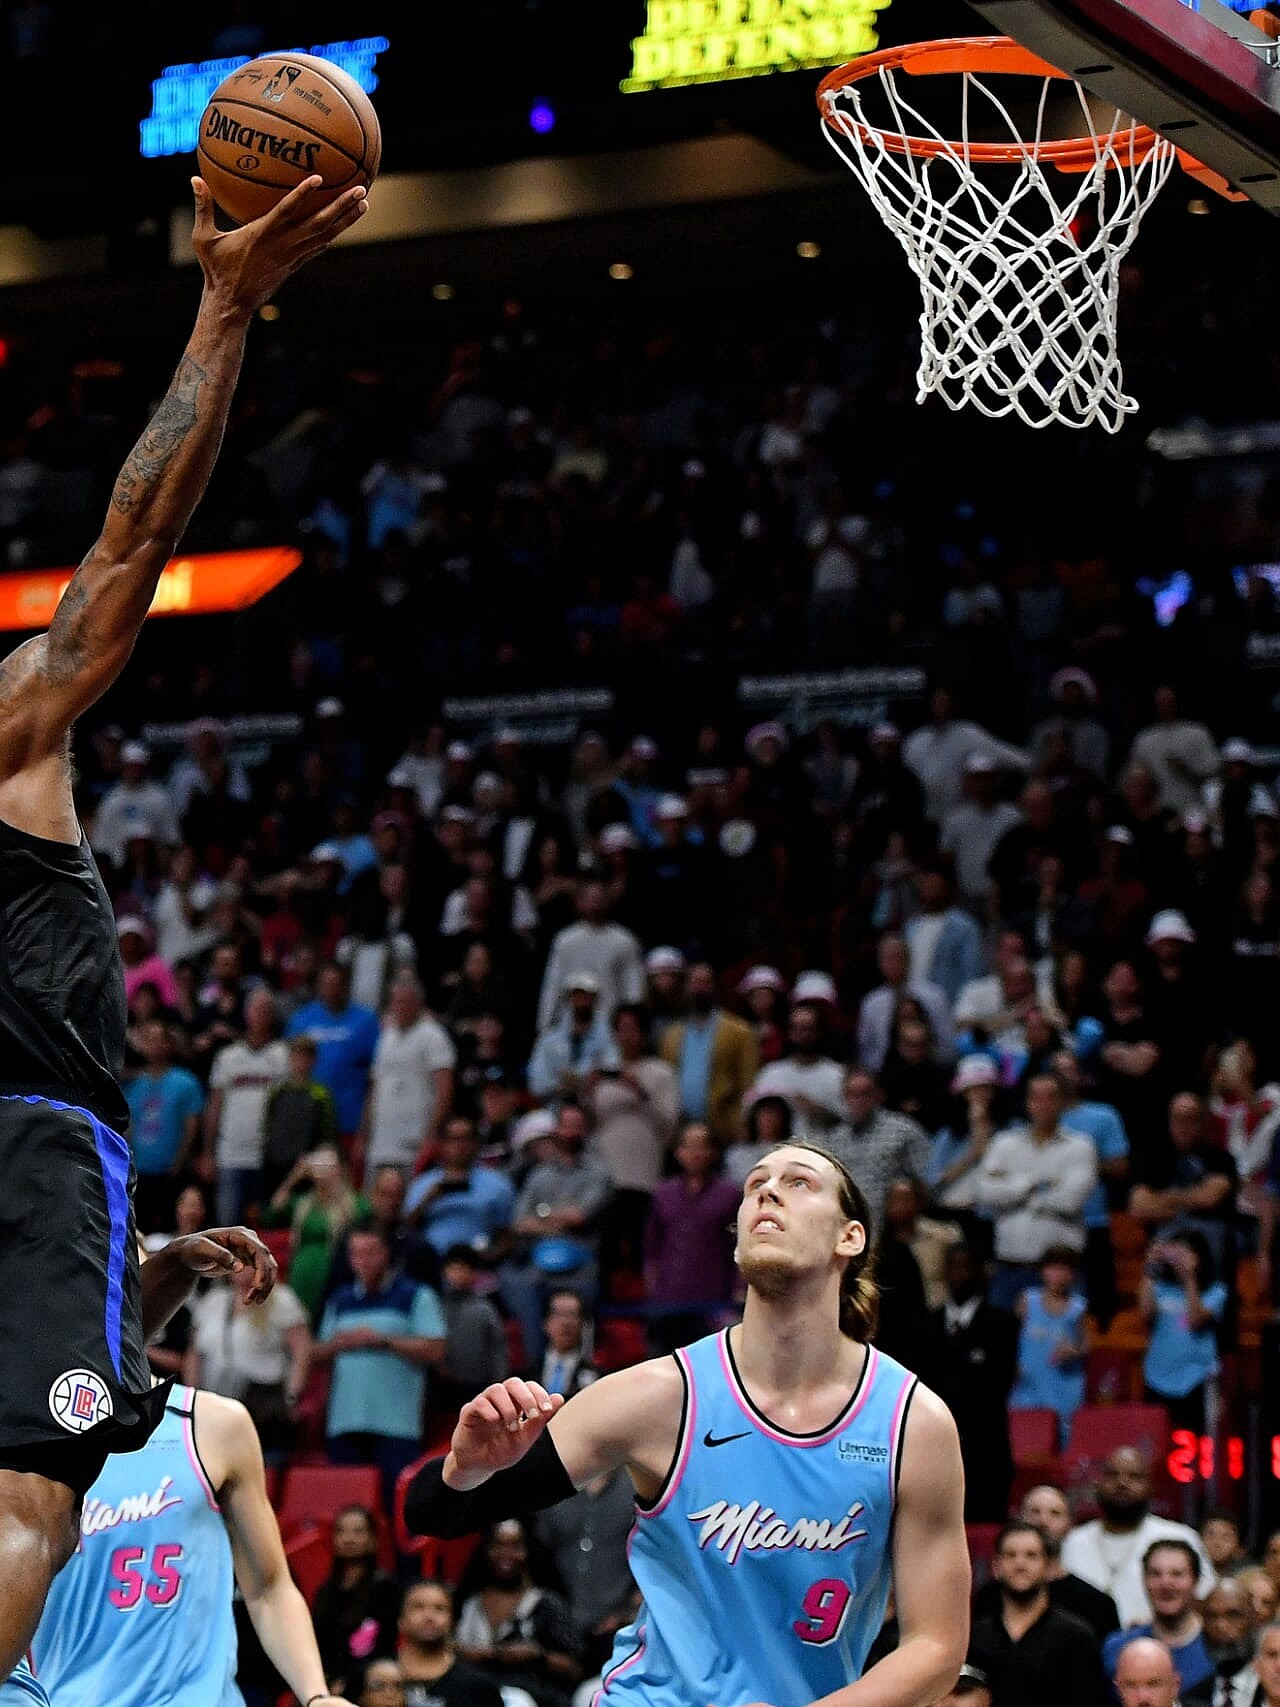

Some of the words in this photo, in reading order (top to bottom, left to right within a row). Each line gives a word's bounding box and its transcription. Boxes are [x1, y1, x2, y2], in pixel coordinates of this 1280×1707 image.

[205, 106, 320, 172] SPALDING
[839, 1440, 888, 1456] Ultimate
[80, 1475, 183, 1538] iami
[686, 1500, 868, 1566] Miami
[109, 1544, 184, 1612] 55
[793, 1578, 854, 1648] 9
